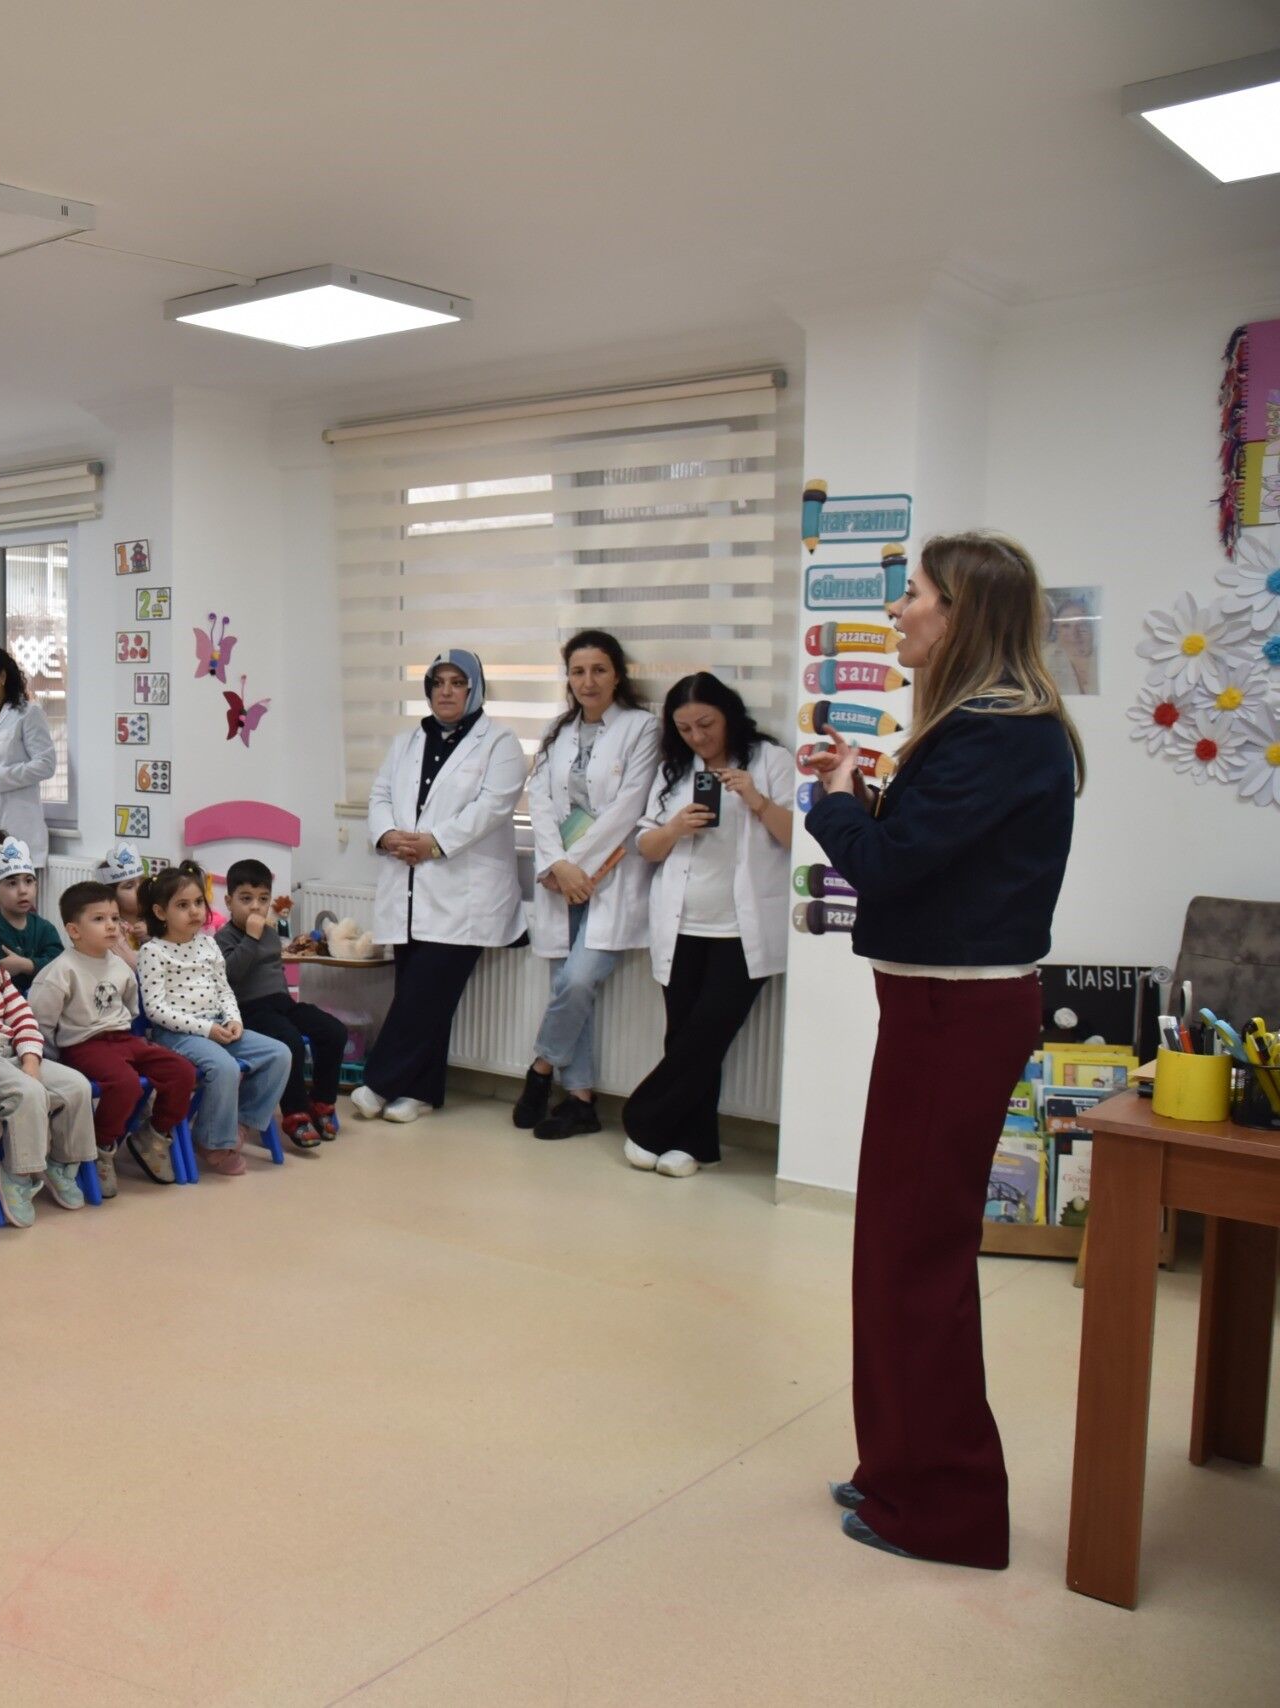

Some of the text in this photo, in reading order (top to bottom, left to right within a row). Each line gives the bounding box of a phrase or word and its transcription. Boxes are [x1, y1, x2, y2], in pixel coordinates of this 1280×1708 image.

[117, 544, 129, 572] 1
[138, 590, 151, 618] 2
[118, 634, 129, 661] 3
[808, 634, 817, 646] 1
[136, 676, 151, 702] 4
[806, 673, 815, 684] 2
[117, 717, 129, 742] 5
[801, 712, 809, 724] 3
[138, 763, 151, 790] 6
[799, 792, 810, 804] 5
[118, 808, 130, 835] 7
[795, 876, 805, 887] 6
[795, 915, 804, 925] 7
